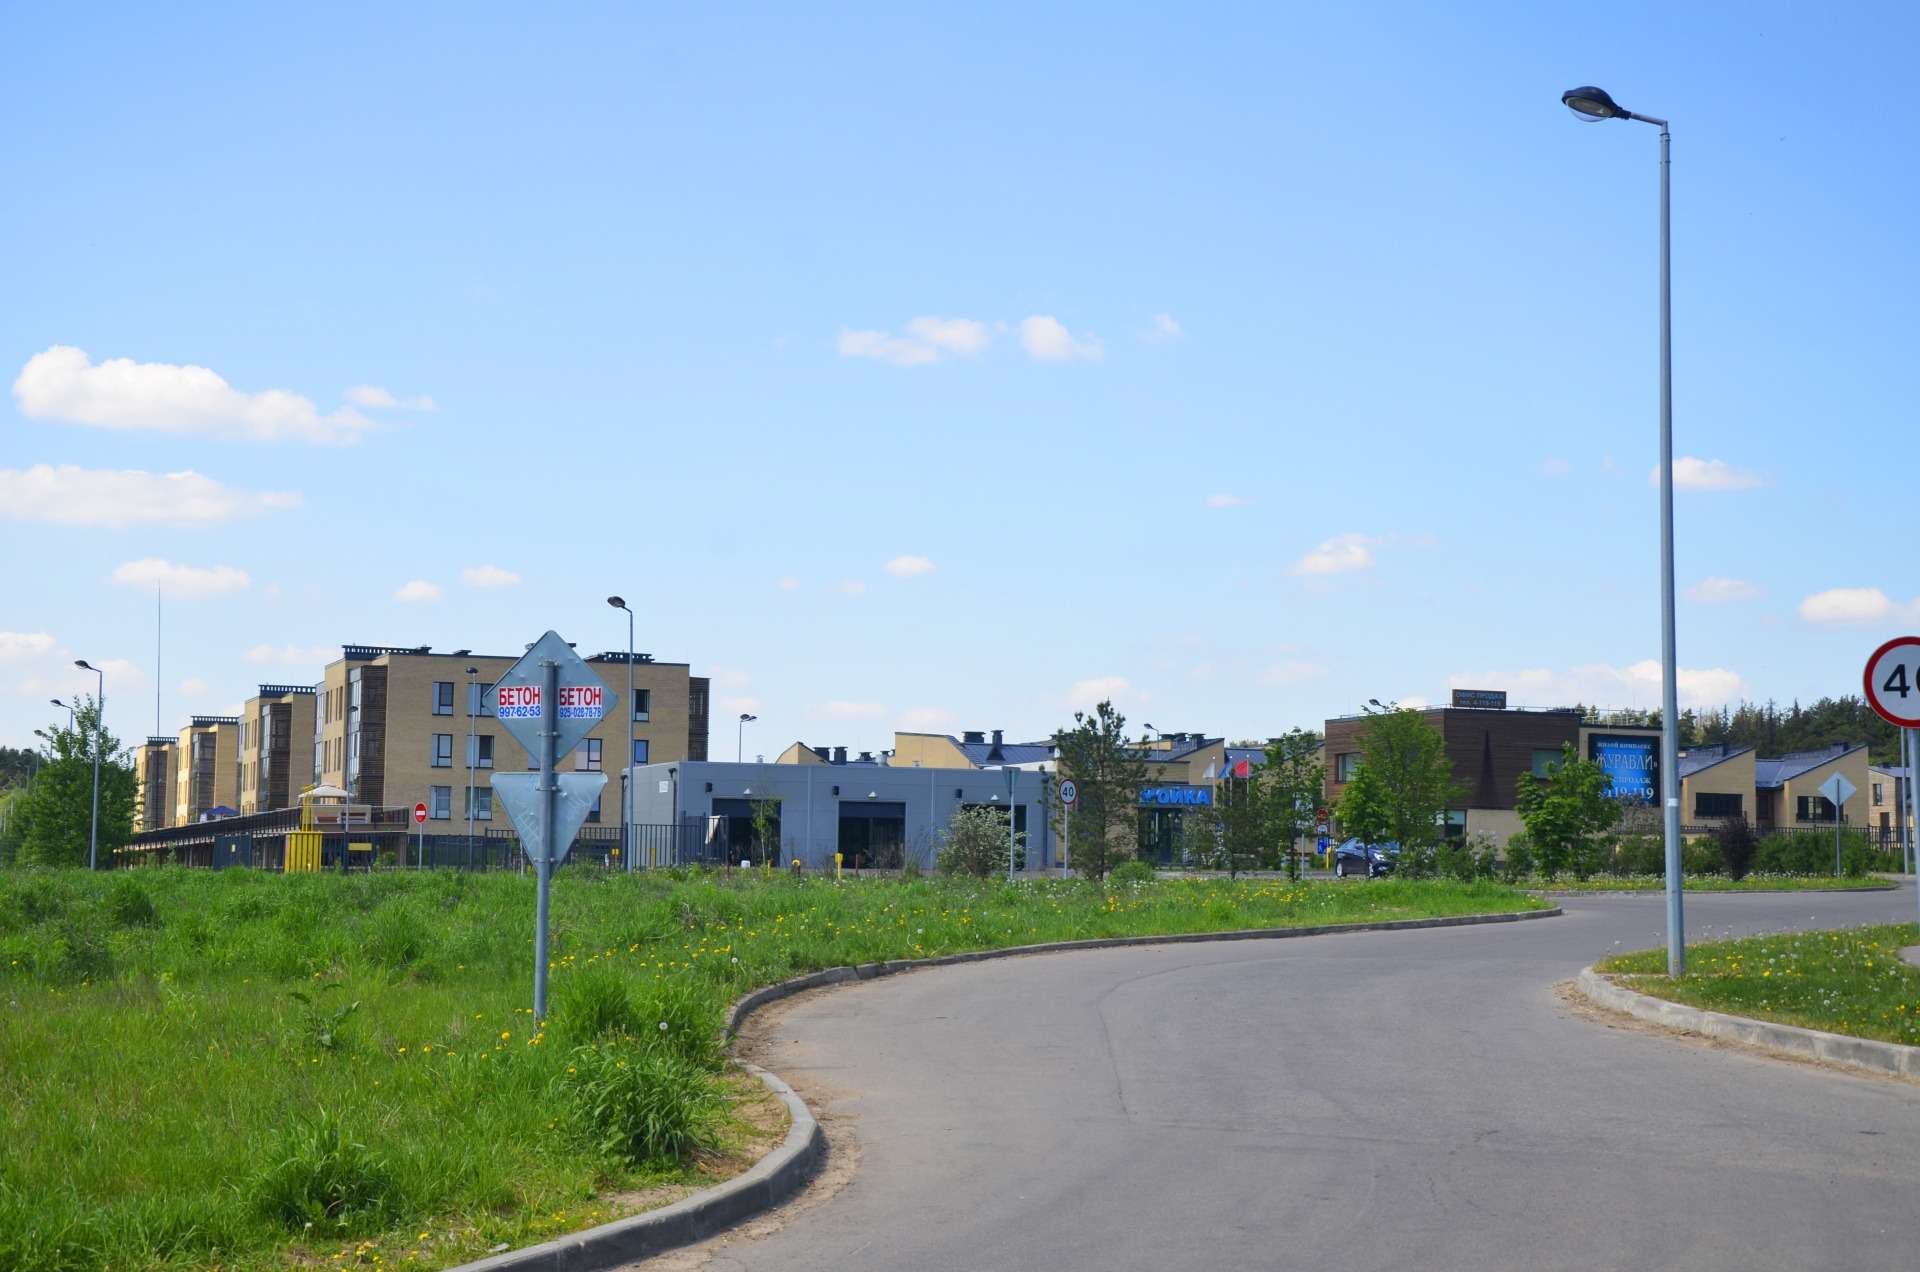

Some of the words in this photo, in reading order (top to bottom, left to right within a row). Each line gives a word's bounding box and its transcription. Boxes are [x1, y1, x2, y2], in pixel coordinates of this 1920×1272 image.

[1883, 663, 1920, 698] 4
[499, 687, 541, 706] БЕТОН
[559, 687, 602, 706] БЕТОН
[499, 706, 541, 717] 997-62-53
[1618, 776, 1652, 784] ПРОДАЖ
[1062, 787, 1074, 797] 40
